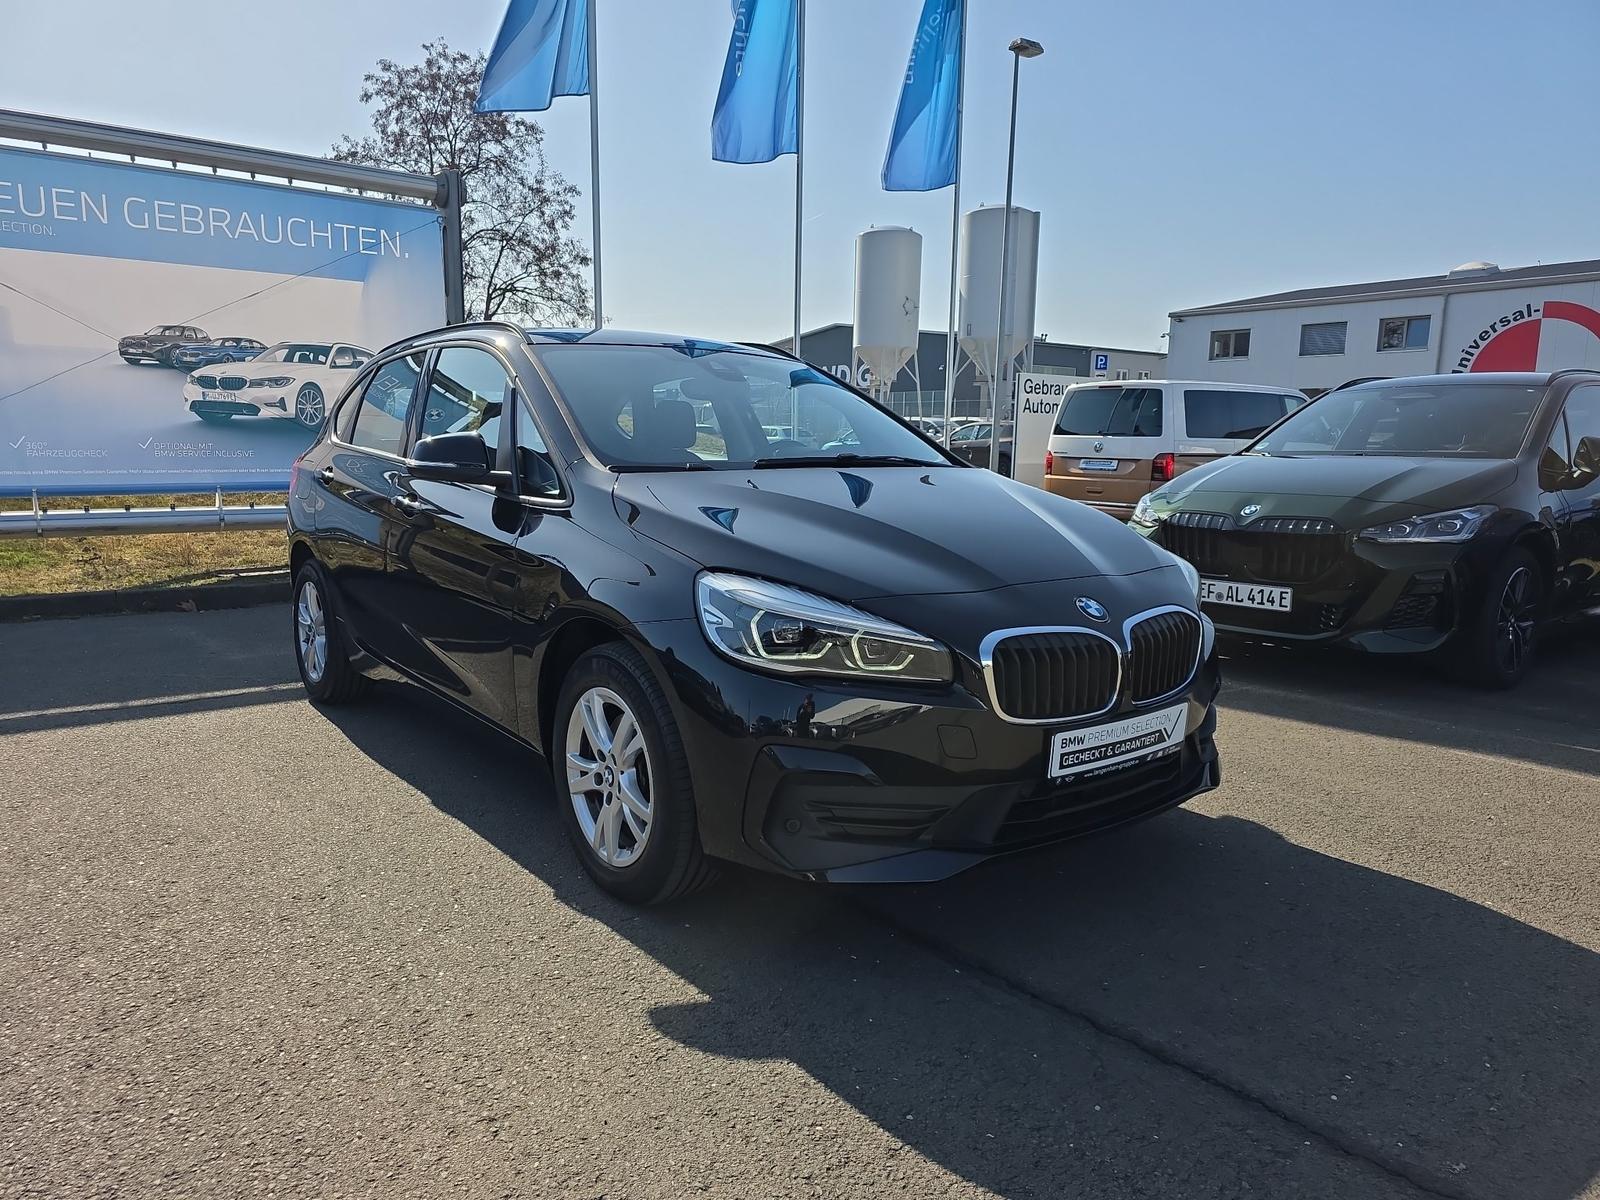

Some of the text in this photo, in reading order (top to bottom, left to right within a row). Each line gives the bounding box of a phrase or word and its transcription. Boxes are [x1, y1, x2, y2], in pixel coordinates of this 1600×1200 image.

[123, 196, 410, 259] GEBRAUCHTEN.
[1452, 304, 1540, 374] niversal-
[1098, 356, 1106, 368] P
[1226, 586, 1243, 602] AL
[1060, 736, 1086, 749] BMW
[1087, 726, 1129, 744] PREMIUM
[1062, 733, 1160, 766] GECHECKT & GARANTIERT
